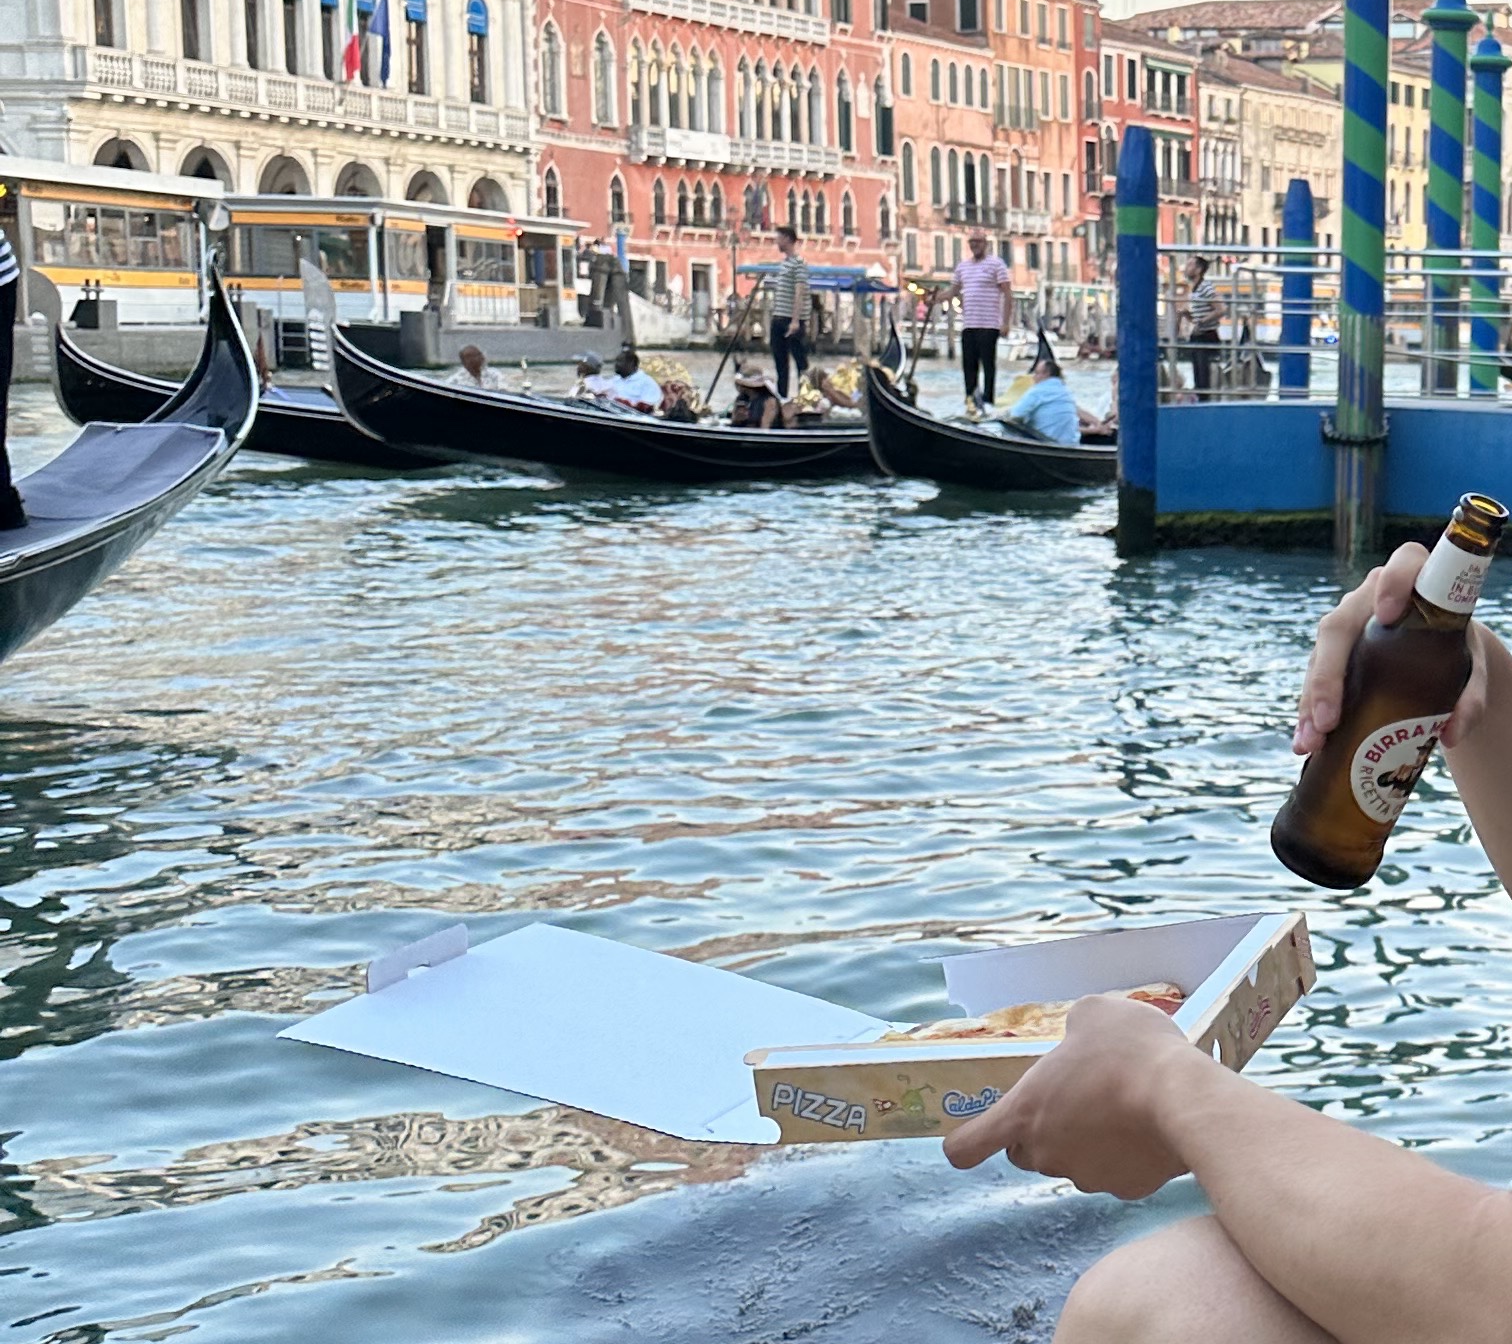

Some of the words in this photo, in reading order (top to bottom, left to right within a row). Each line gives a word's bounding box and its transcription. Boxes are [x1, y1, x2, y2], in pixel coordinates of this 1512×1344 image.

[1365, 724, 1425, 764] BIRRA
[1359, 764, 1391, 816] RICETTA
[771, 1081, 867, 1134] PIZZA
